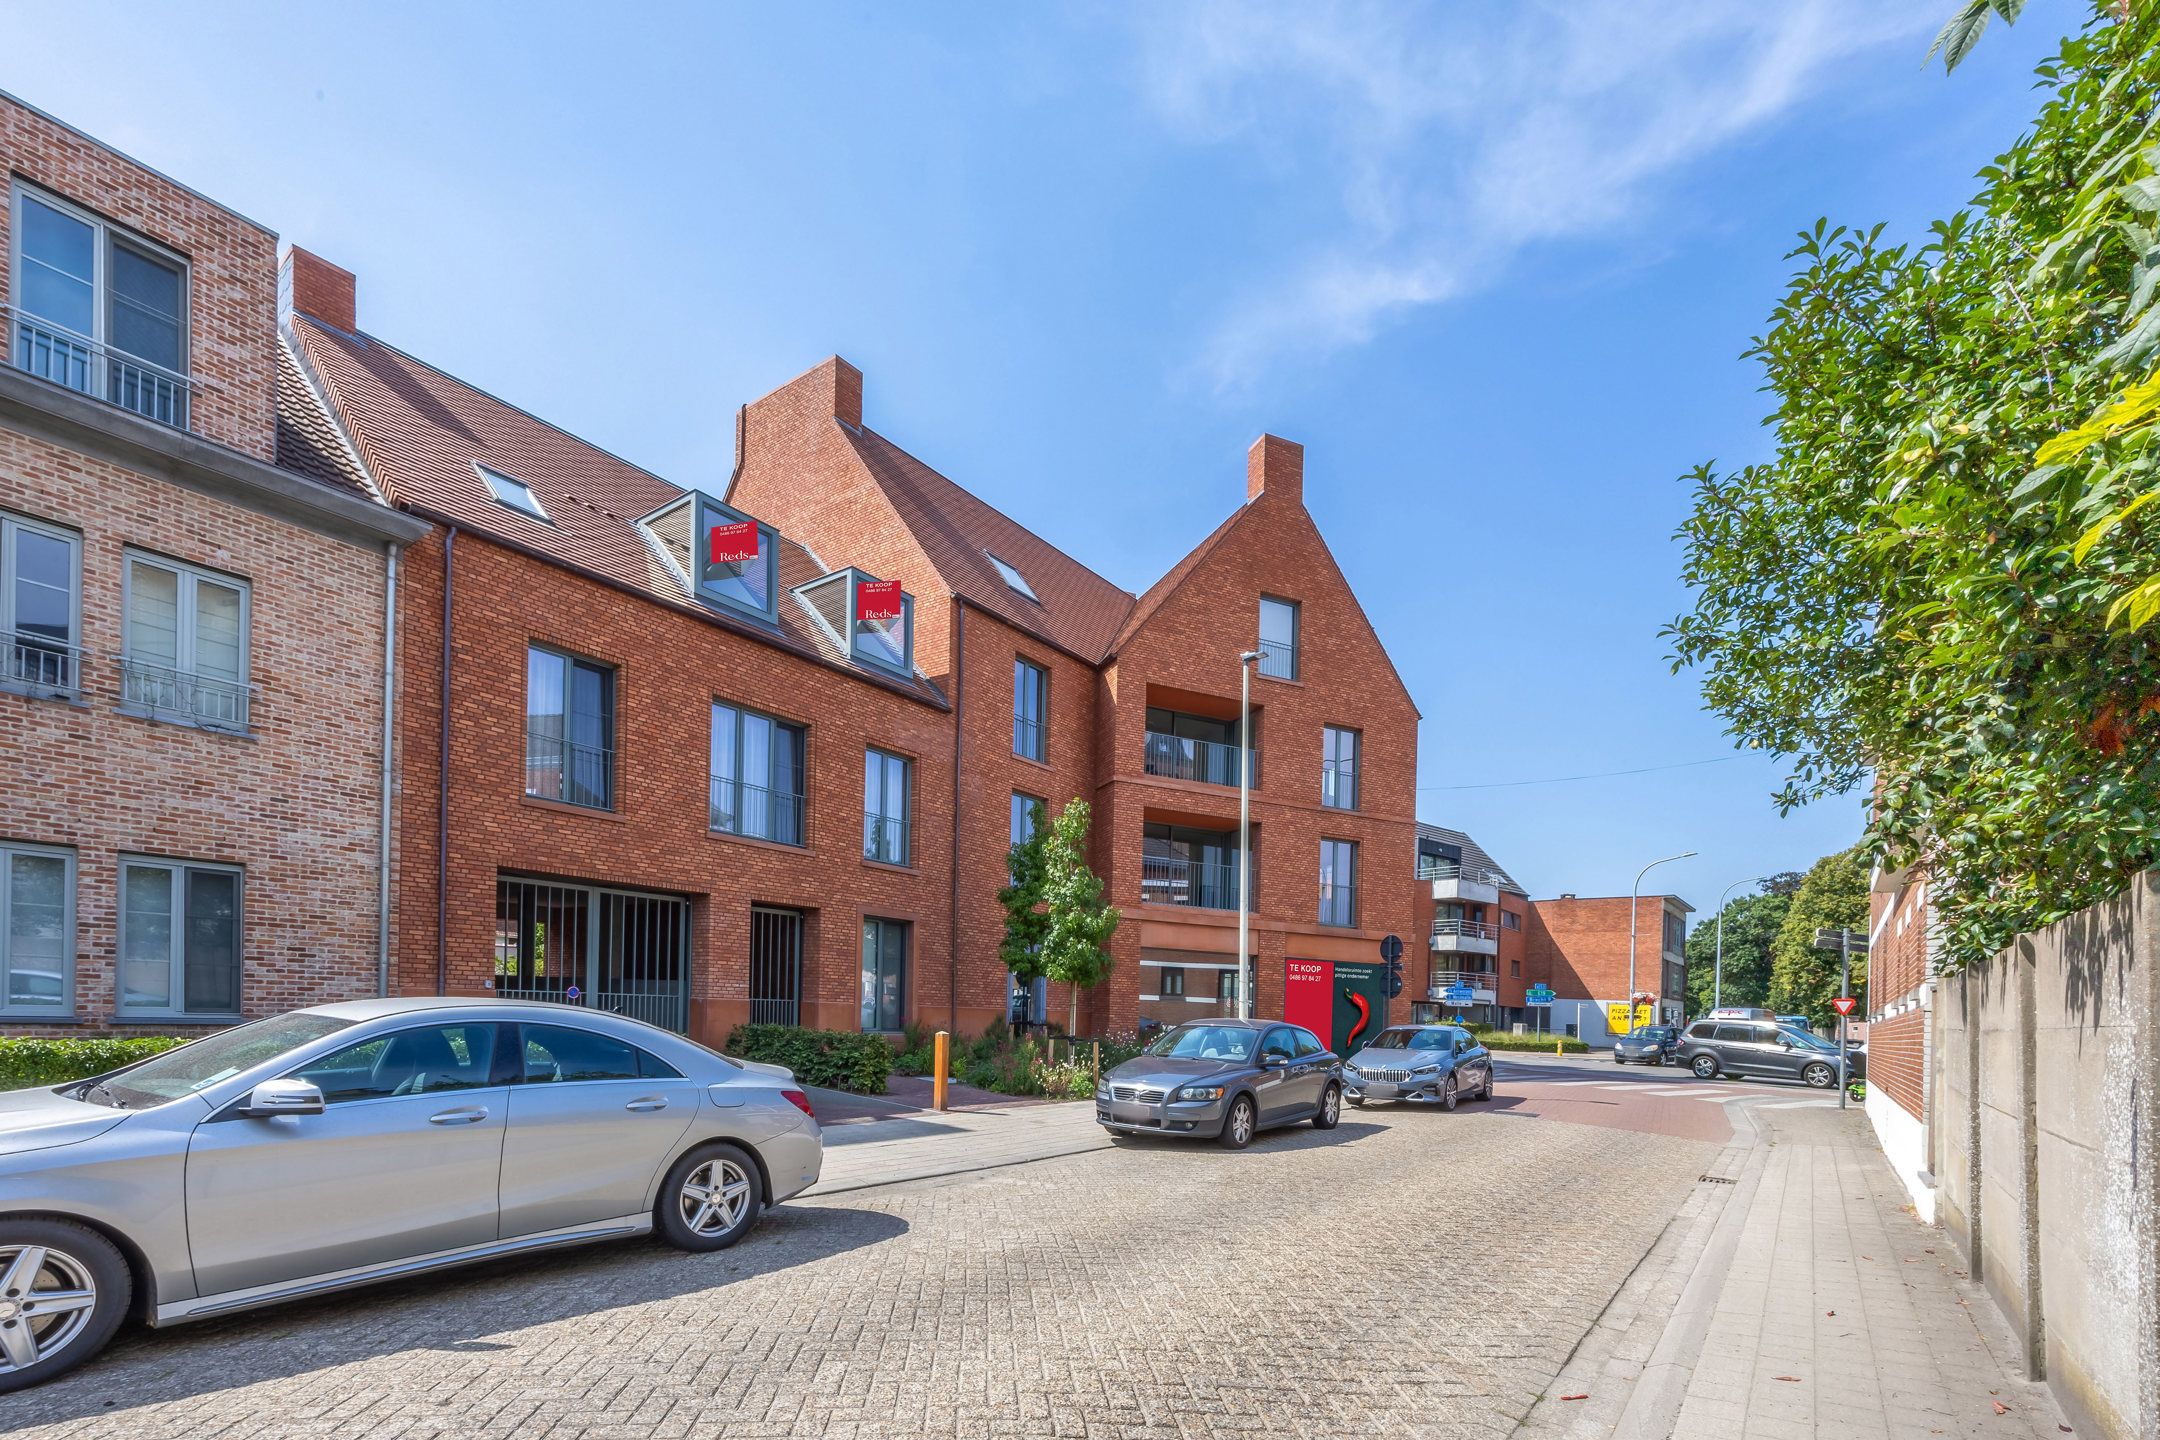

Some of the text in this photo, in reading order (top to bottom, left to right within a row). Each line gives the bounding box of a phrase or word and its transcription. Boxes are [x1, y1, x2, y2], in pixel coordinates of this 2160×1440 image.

[729, 523, 748, 531] KOOP
[720, 550, 749, 562] Reds
[865, 608, 892, 619] Reds
[1289, 963, 1322, 973] TE KOOP
